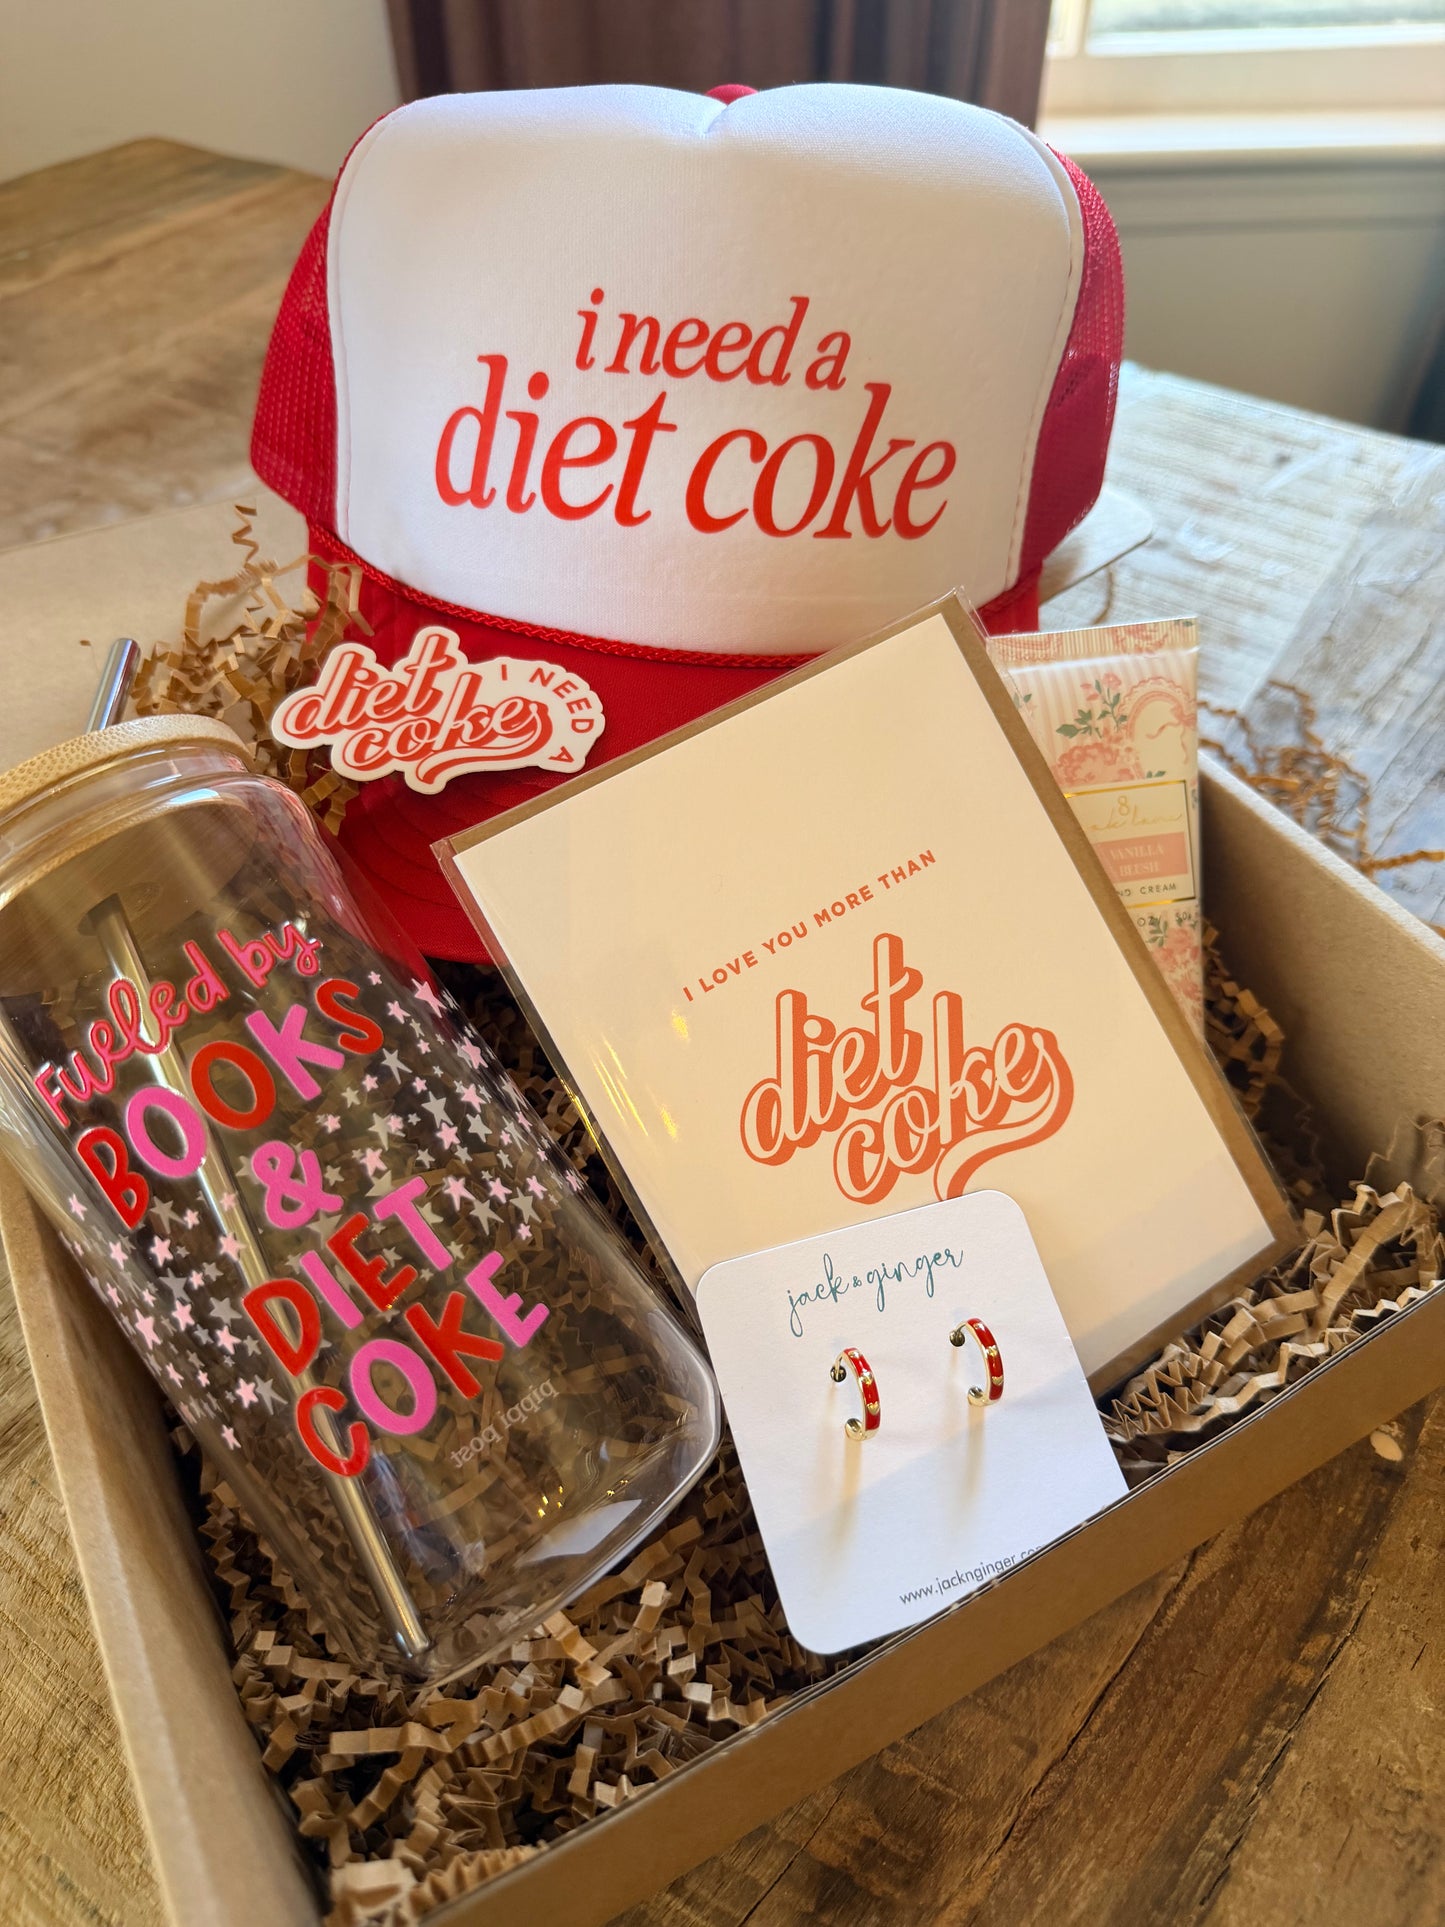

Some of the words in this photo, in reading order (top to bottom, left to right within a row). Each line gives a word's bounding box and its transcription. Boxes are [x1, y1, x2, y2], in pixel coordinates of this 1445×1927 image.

[576, 287, 605, 371] i
[604, 296, 810, 386] need
[805, 331, 852, 391] a
[435, 354, 678, 528] diet
[685, 382, 958, 540] coke
[282, 633, 457, 740] diet
[501, 664, 508, 681] I
[528, 667, 595, 734] NEED
[342, 671, 554, 785] coke
[548, 746, 575, 763] A
[1110, 844, 1165, 861] VANILLA
[1119, 861, 1160, 877] BLUSH
[1139, 882, 1177, 895] CREAM
[216, 921, 323, 988] by
[683, 986, 694, 1002] I
[698, 950, 759, 993] LOVE
[761, 921, 808, 955] YOU
[813, 884, 875, 928] MORE
[877, 849, 936, 889] THAN
[740, 932, 924, 1166] diet
[833, 990, 1075, 1205] coke
[76, 978, 385, 1230] BOOKS
[251, 1140, 344, 1230] &
[243, 1176, 454, 1378] DIET
[787, 1252, 850, 1338] jack
[866, 1248, 964, 1312] ginger
[296, 1250, 551, 1478] COKE
